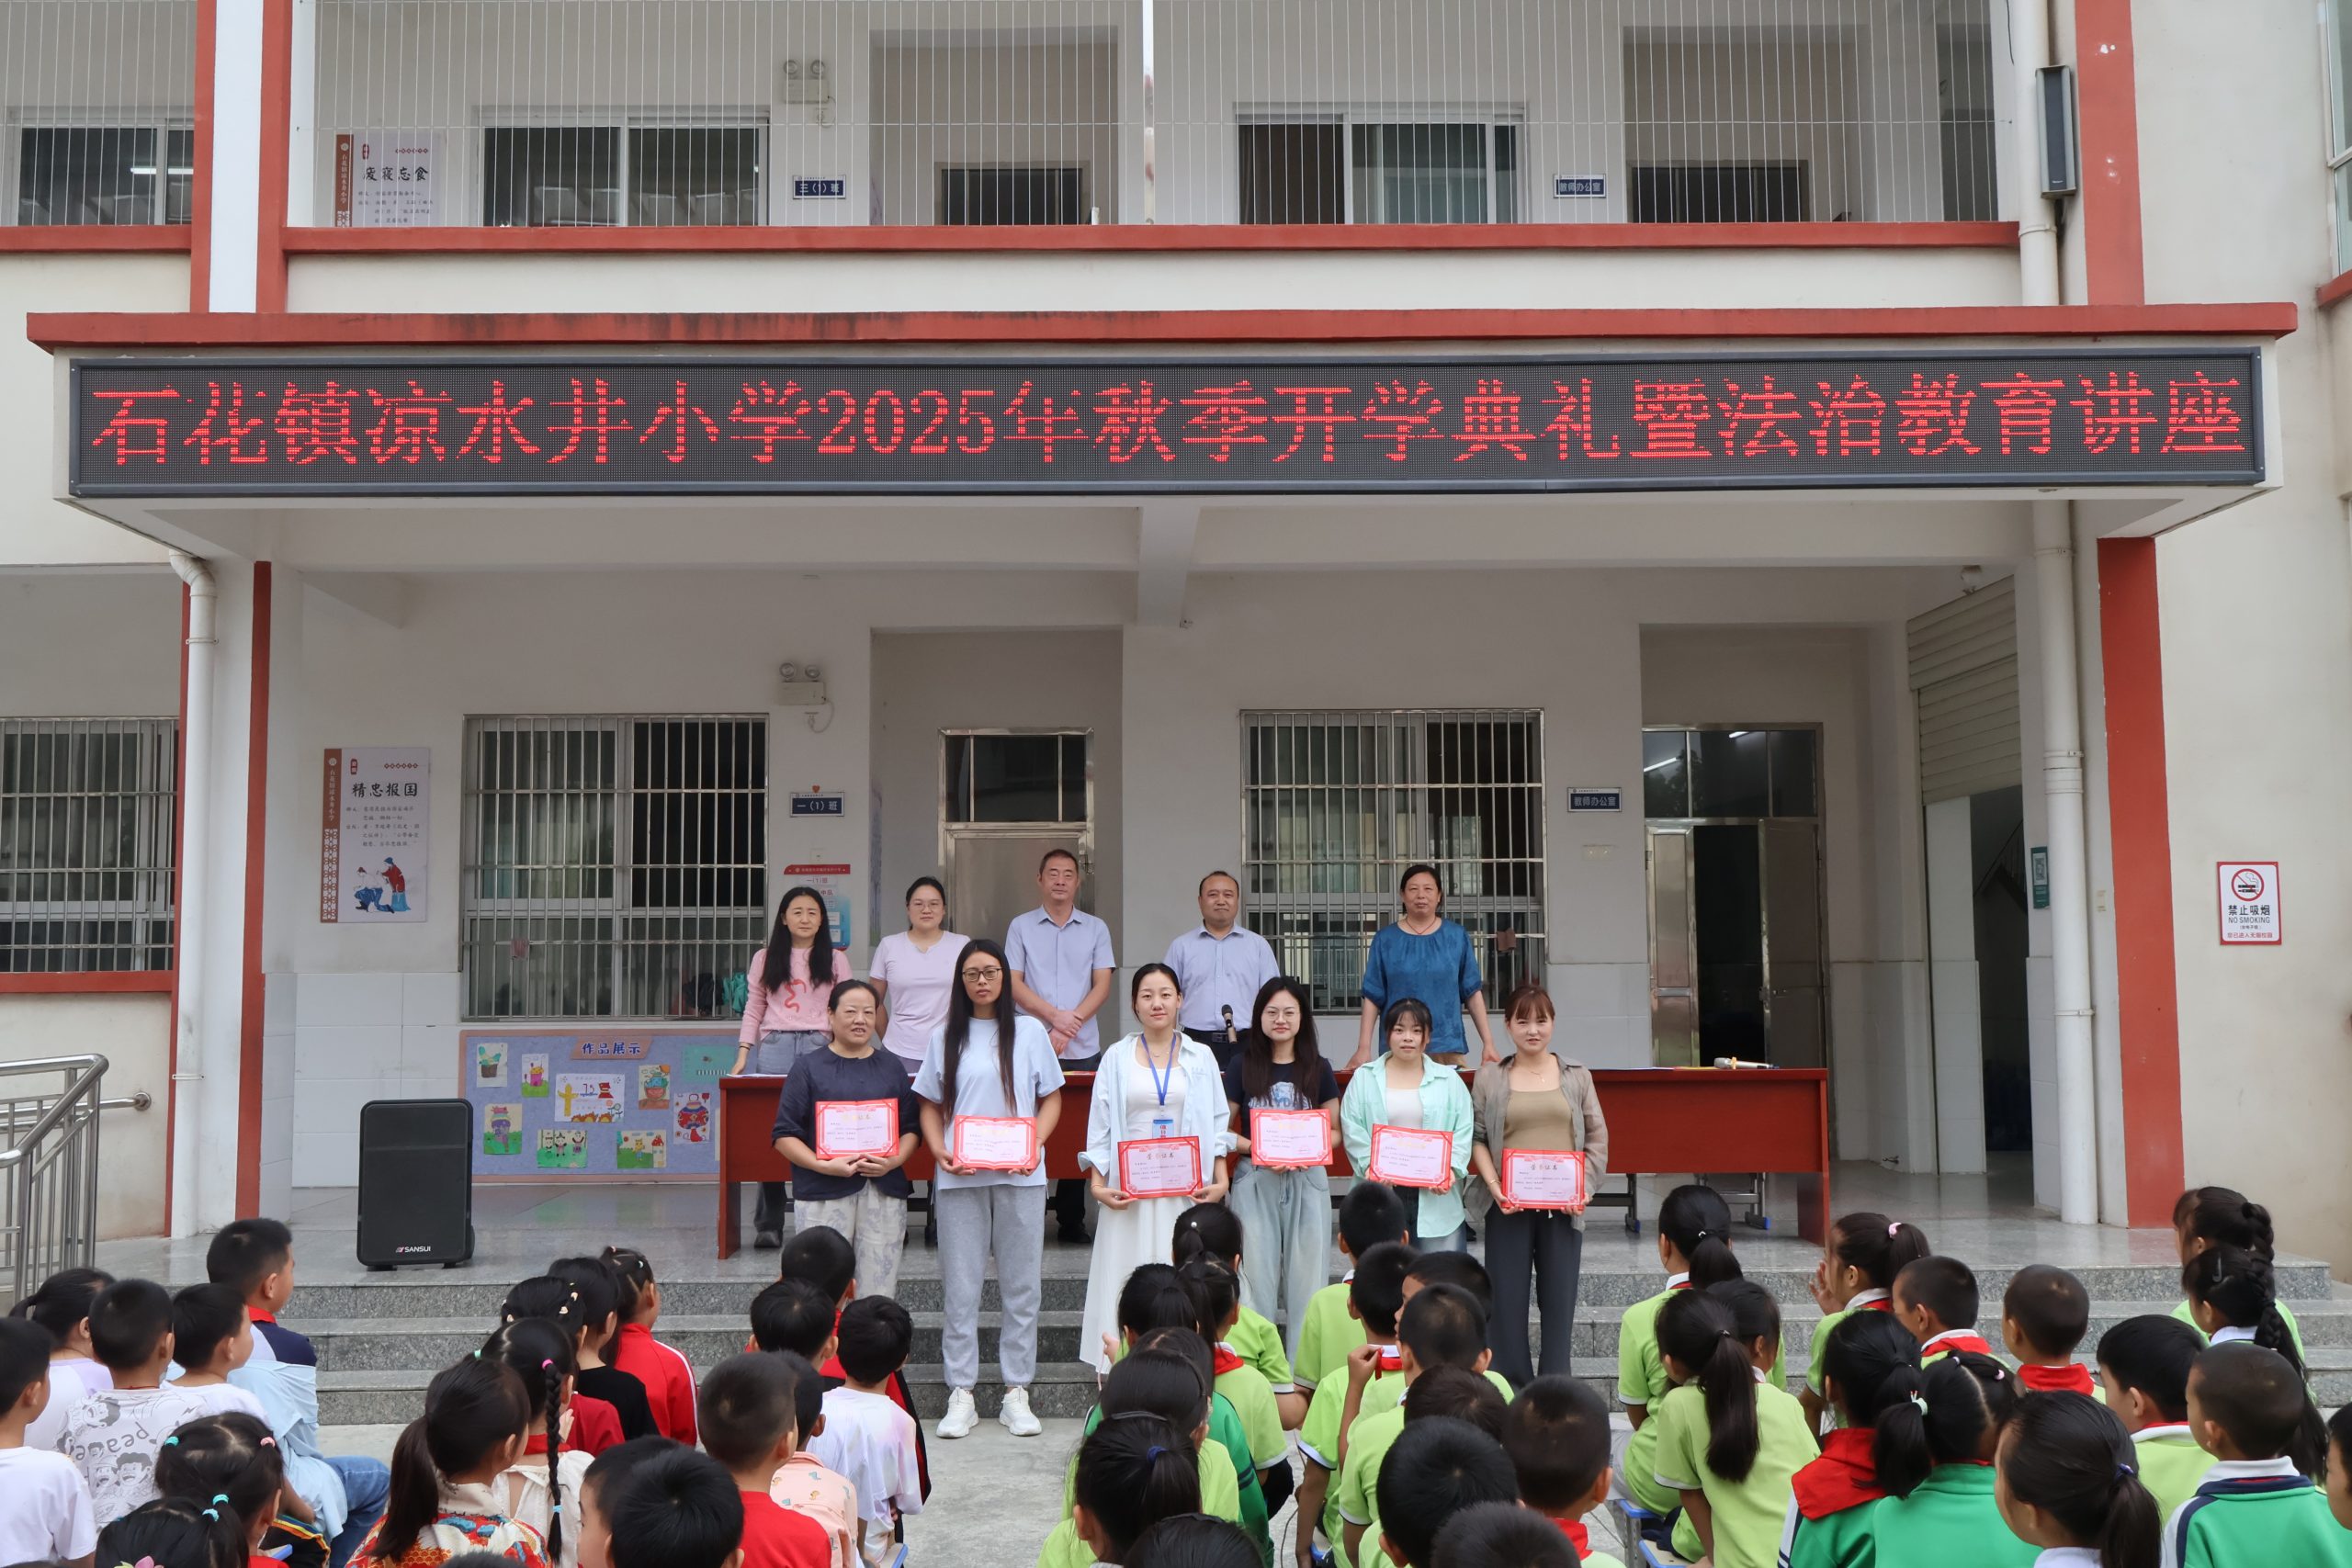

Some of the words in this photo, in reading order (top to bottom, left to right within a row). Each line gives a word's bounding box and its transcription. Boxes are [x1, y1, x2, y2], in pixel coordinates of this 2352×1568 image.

[93, 372, 2244, 464] 石花镇凉水井小学2025年秋季开学典礼暨法治教育讲座
[351, 782, 418, 797] 精忠报国
[1574, 796, 1616, 807] 教师办公室
[2228, 905, 2270, 916] 禁止吸烟
[582, 1042, 641, 1055] 作品展示
